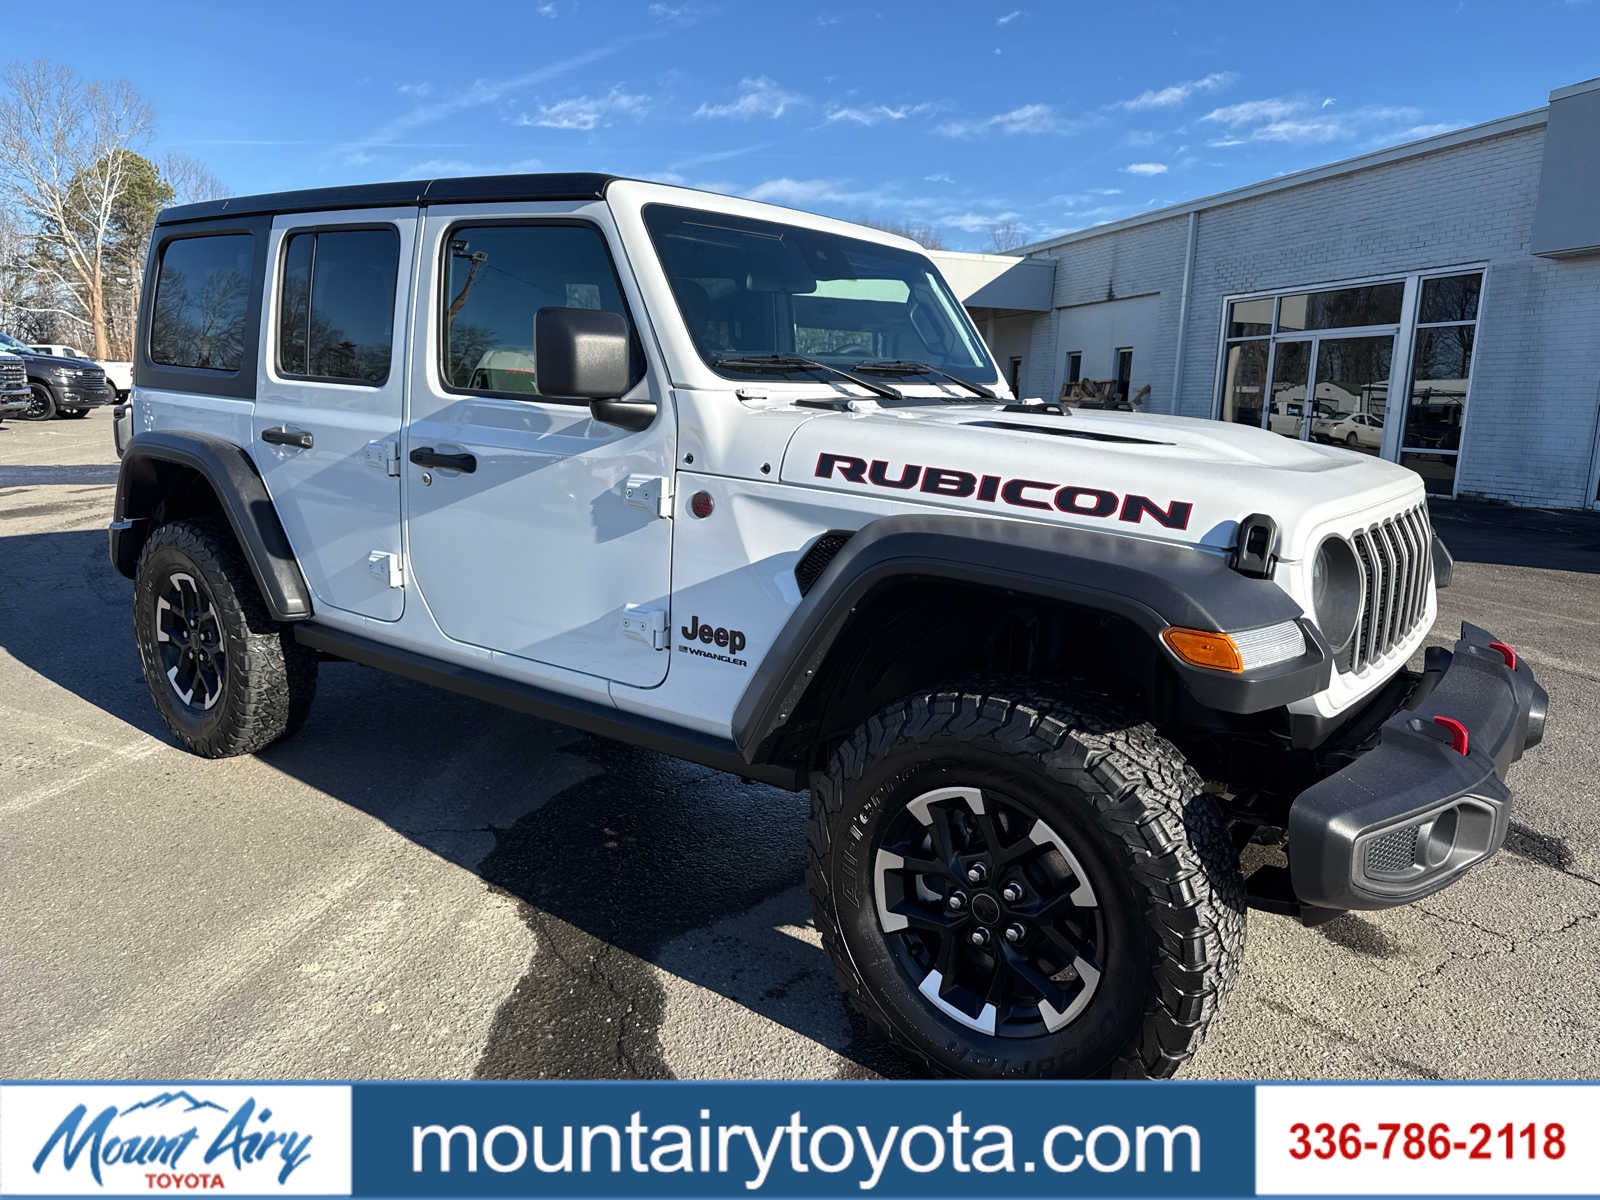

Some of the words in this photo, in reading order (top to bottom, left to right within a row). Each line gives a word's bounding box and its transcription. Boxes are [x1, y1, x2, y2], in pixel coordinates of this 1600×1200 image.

[814, 452, 1194, 531] RUBICON
[681, 615, 746, 655] Jeep
[688, 647, 748, 667] WRANGLER
